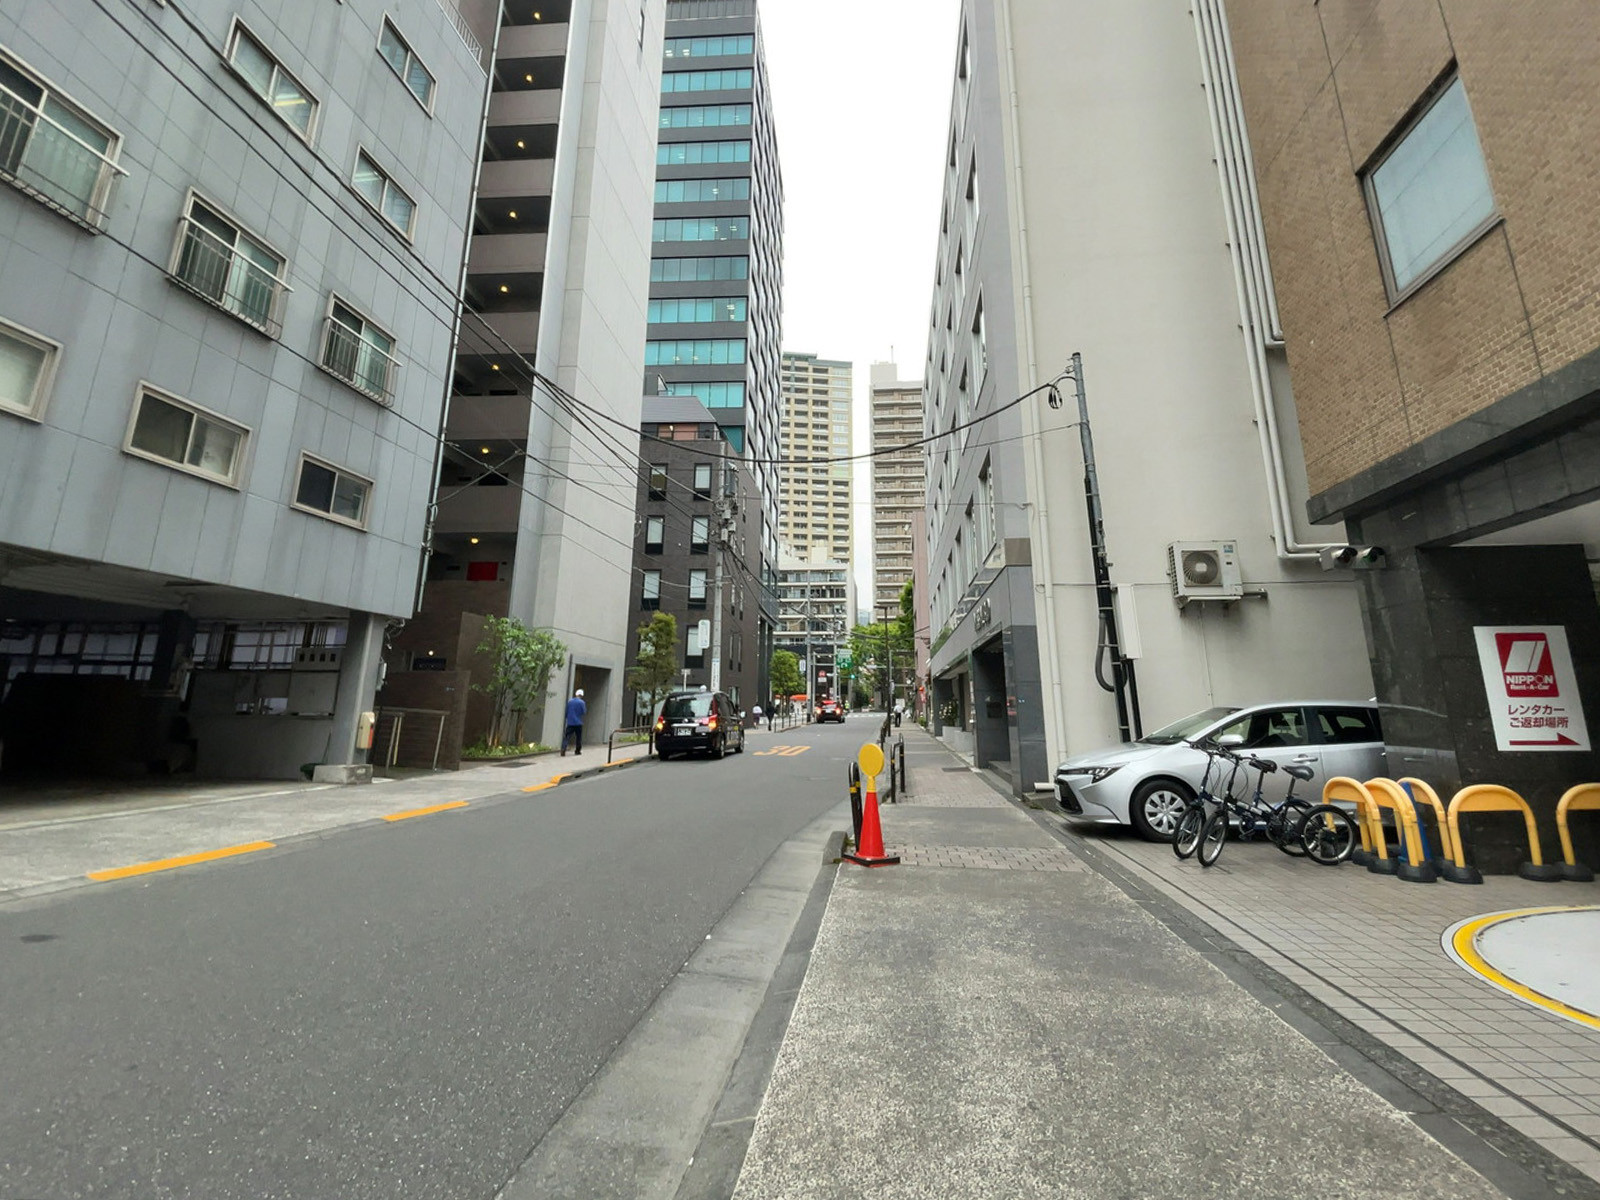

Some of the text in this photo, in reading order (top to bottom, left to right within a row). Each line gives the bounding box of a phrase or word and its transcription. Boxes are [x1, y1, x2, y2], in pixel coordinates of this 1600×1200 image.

[1506, 675, 1553, 684] NIPPON
[1508, 704, 1565, 715] レンタカー
[1510, 717, 1568, 728] ご返却場所
[752, 745, 811, 756] 30
